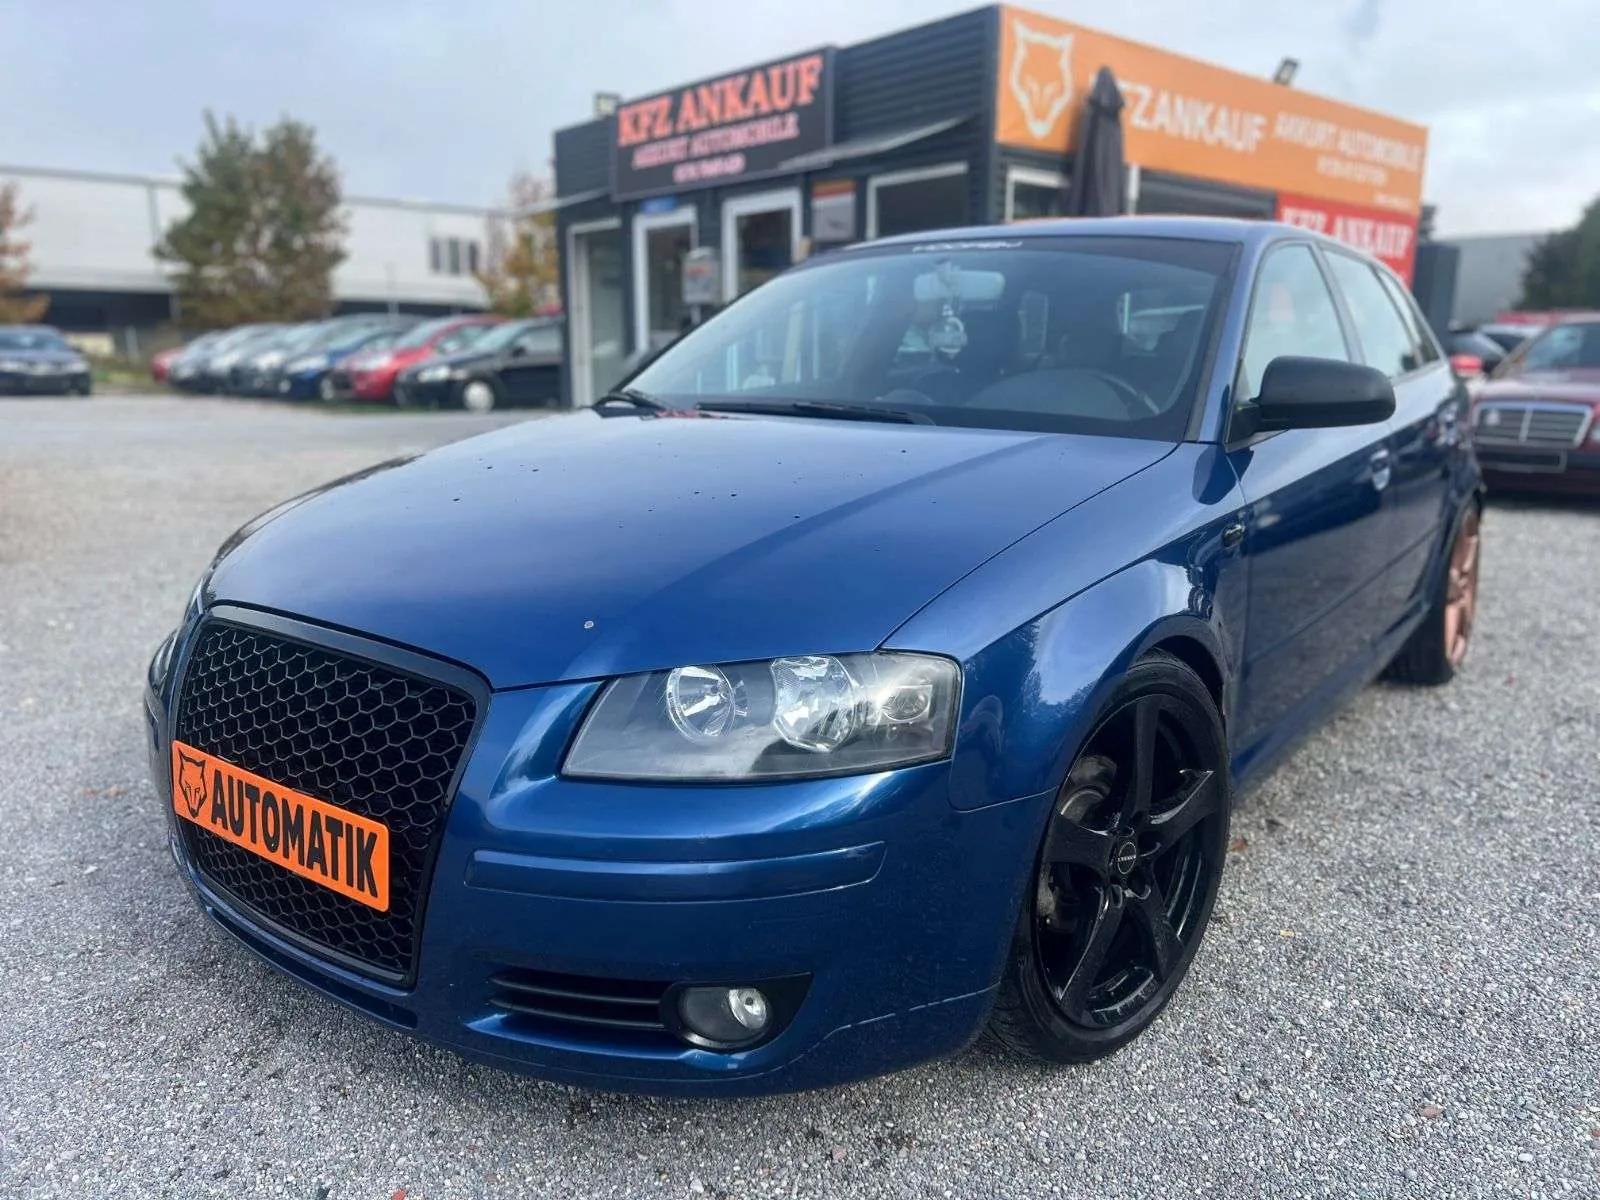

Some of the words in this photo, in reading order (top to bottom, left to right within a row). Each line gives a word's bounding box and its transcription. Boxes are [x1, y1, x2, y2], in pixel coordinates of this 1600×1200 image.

[617, 95, 673, 147] KFZ
[675, 54, 823, 133] ANKAUF
[210, 768, 379, 899] AUTOMATIK
